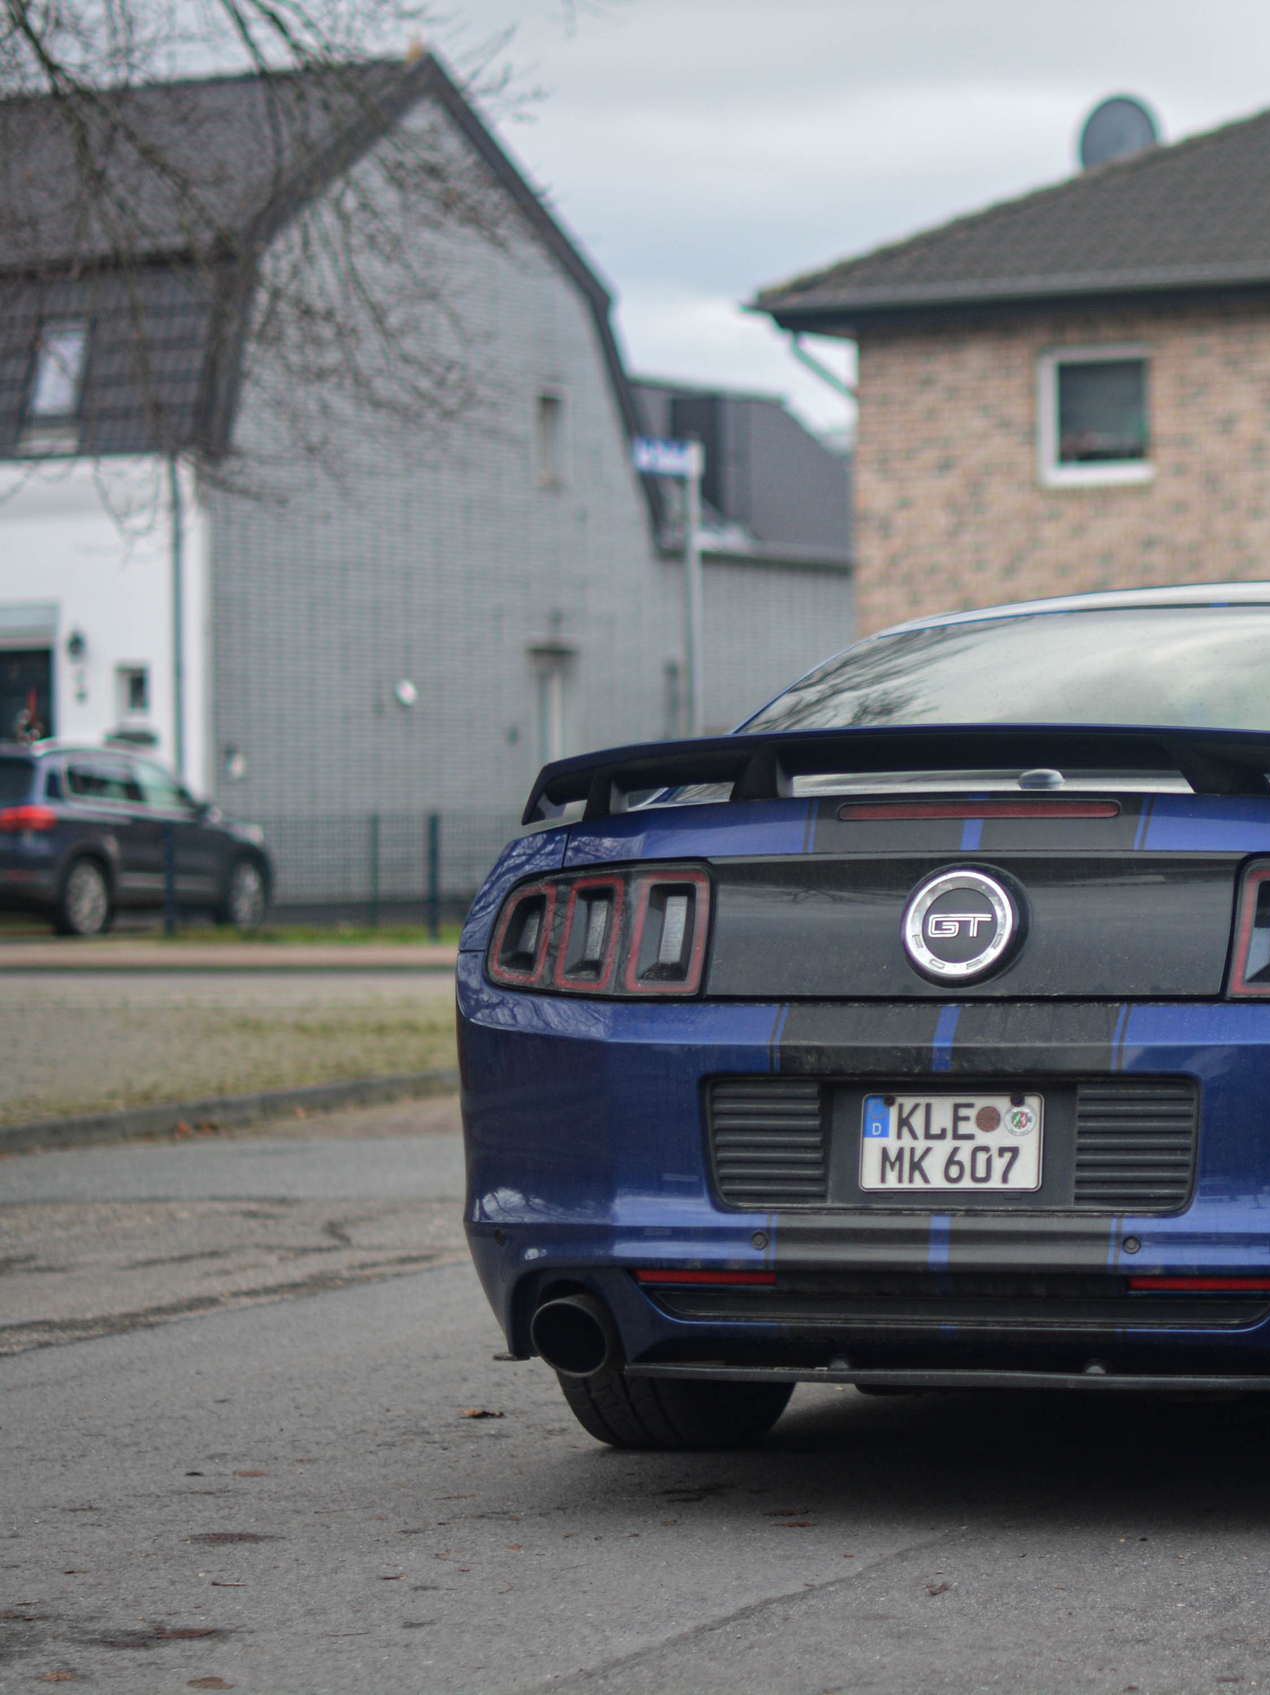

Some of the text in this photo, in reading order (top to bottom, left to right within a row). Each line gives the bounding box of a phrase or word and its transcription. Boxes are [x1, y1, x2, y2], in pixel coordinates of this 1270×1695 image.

[928, 913, 992, 938] GT
[872, 1122, 882, 1136] D
[896, 1102, 976, 1141] KLE
[880, 1145, 1020, 1184] MK 607
